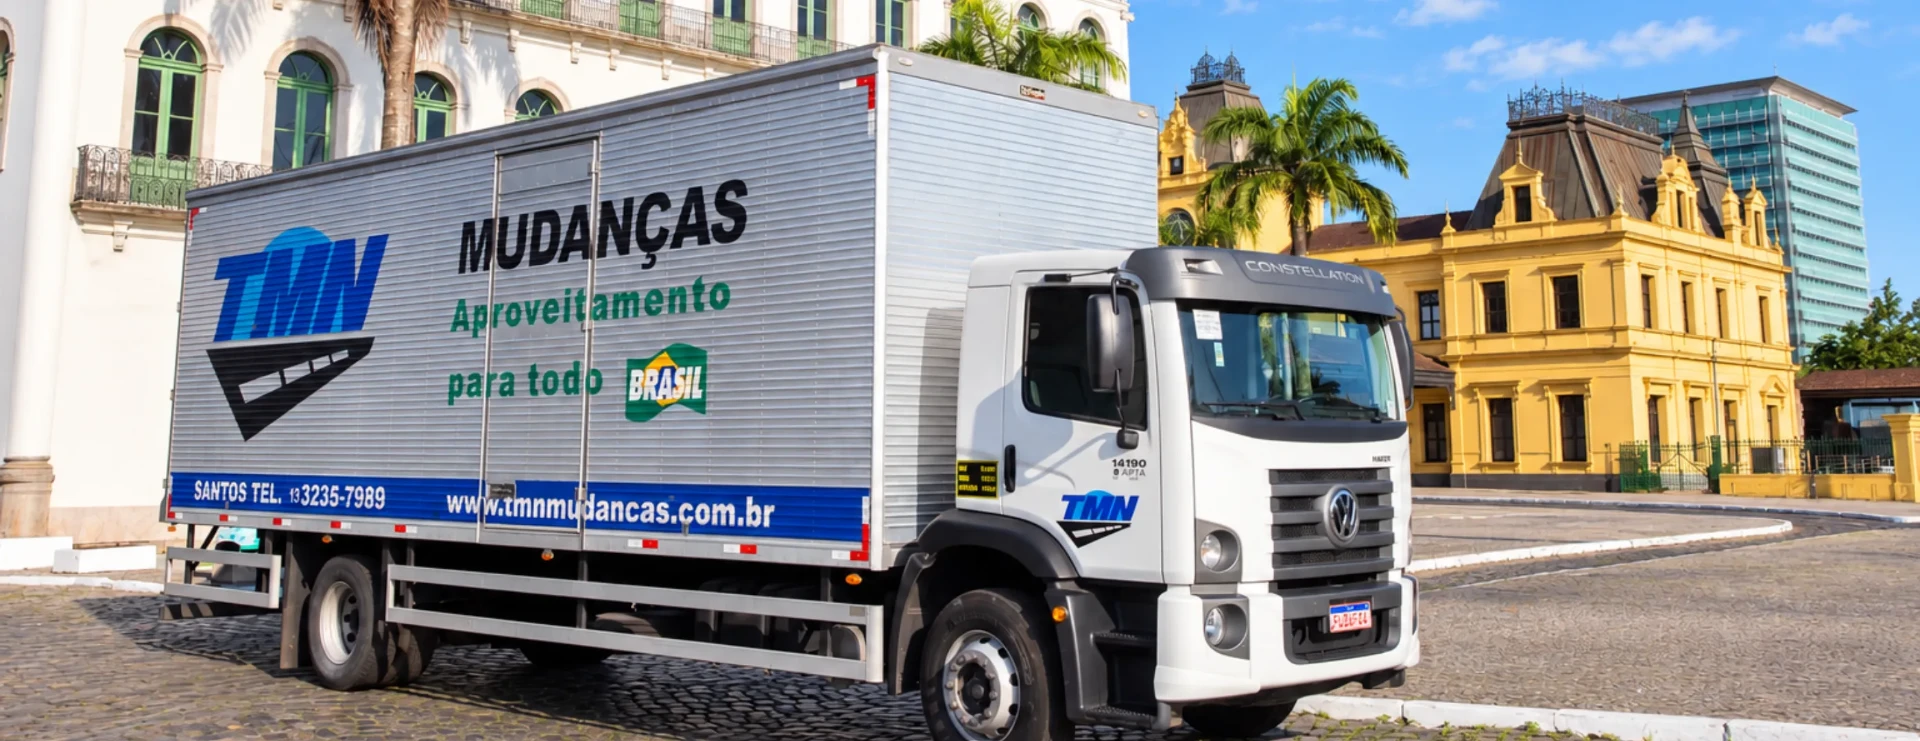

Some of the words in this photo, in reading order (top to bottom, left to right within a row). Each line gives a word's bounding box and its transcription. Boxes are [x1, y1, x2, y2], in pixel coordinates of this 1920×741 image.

[458, 179, 748, 274] MUDANÇAS
[213, 233, 390, 343] TMN
[1245, 260, 1365, 285] CONSTELLATION
[450, 276, 731, 338] Aproveitamento
[447, 371, 515, 406] para
[528, 360, 603, 397] todo
[628, 366, 703, 401] BRASIL
[1111, 458, 1147, 468] 14190
[194, 480, 247, 502] SANTOS
[251, 482, 281, 504] TEL.
[1061, 494, 1139, 521] TMN
[446, 493, 776, 528] www.tmnmudancas.com.br
